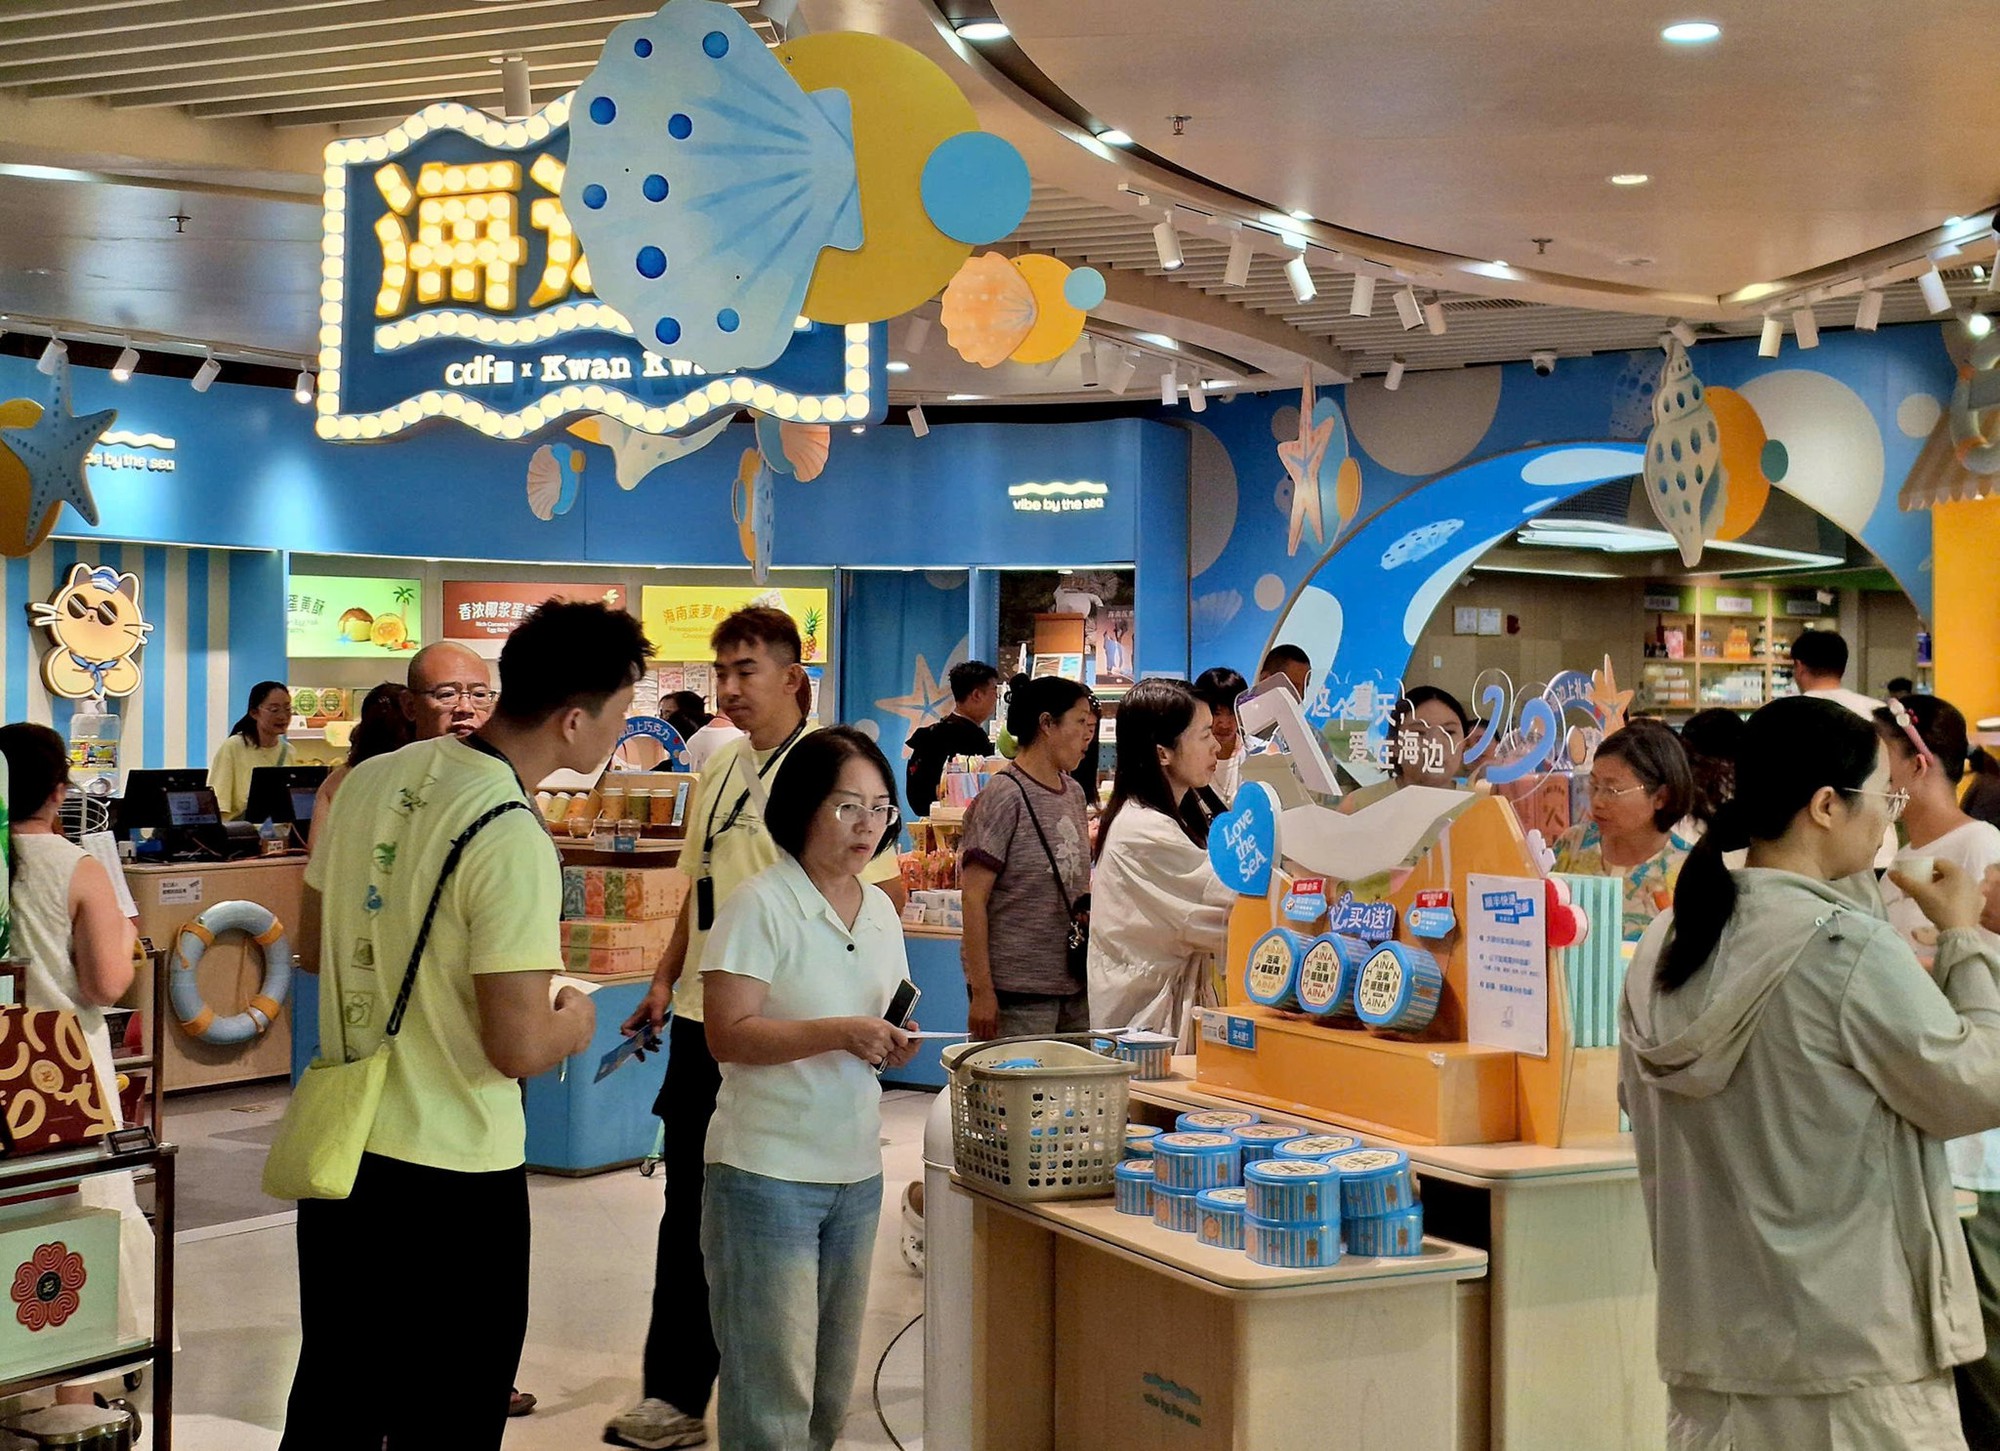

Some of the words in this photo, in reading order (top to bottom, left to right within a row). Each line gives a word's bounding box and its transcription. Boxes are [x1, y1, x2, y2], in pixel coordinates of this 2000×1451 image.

[540, 354, 632, 383] Kwan
[642, 350, 736, 378] Kw
[103, 452, 121, 470] by
[122, 454, 147, 468] the
[148, 457, 176, 472] sea
[1012, 497, 1042, 511] vibe
[1043, 497, 1060, 513] by
[1061, 498, 1082, 511] the
[1083, 497, 1104, 510] sea
[1348, 729, 1445, 774] 爱在海边
[1222, 808, 1254, 850] Love
[1235, 834, 1257, 861] the
[1347, 906, 1392, 929] 买4送1
